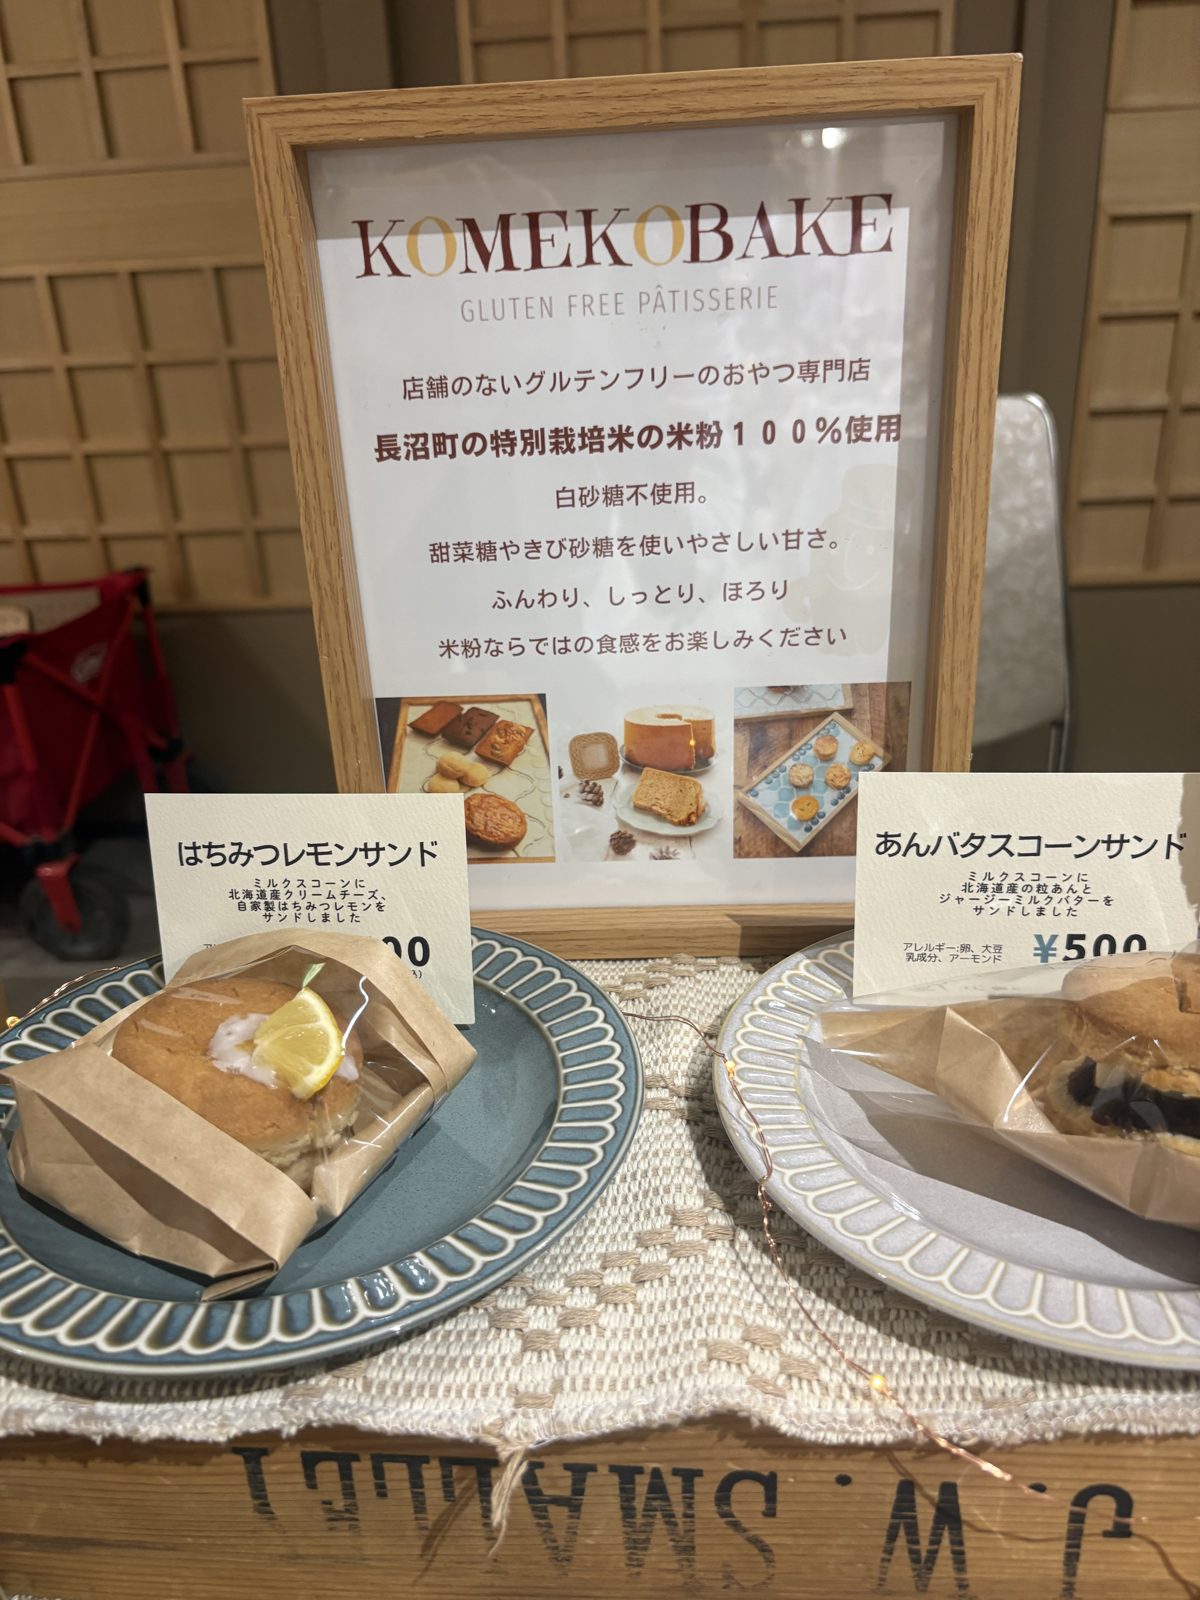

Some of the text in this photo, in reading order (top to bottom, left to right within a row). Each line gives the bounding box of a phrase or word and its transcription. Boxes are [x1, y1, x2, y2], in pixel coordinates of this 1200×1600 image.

[352, 193, 894, 278] KOMEKOBAKE
[460, 284, 779, 323] GLUTEN FREE PÂTISSERIE
[402, 357, 872, 401] 店舗のないグルテンフリーのおやつ専門店
[555, 481, 708, 510] 白砂糖不使用。
[428, 528, 841, 565] 甜菜糖やきび砂糖を使いやさしい甘さ。
[438, 626, 848, 660] 米粉ならではの食感をお楽しみください
[178, 840, 439, 867] はちみつレモンサンド
[875, 831, 1187, 860] あんバタスコーンサンド
[254, 878, 366, 888] ミルクスコーンに
[968, 871, 1088, 882] ミルクスコーンに
[961, 882, 1092, 894] 北海道産の粒あんと
[237, 901, 386, 912] 自家製はちみつレモンを
[939, 893, 1114, 906] ジャージーミルクバターを
[262, 912, 361, 923] サンドしました
[973, 906, 1078, 917] サンドしました
[905, 952, 1002, 964] 乳成分、アーモンド
